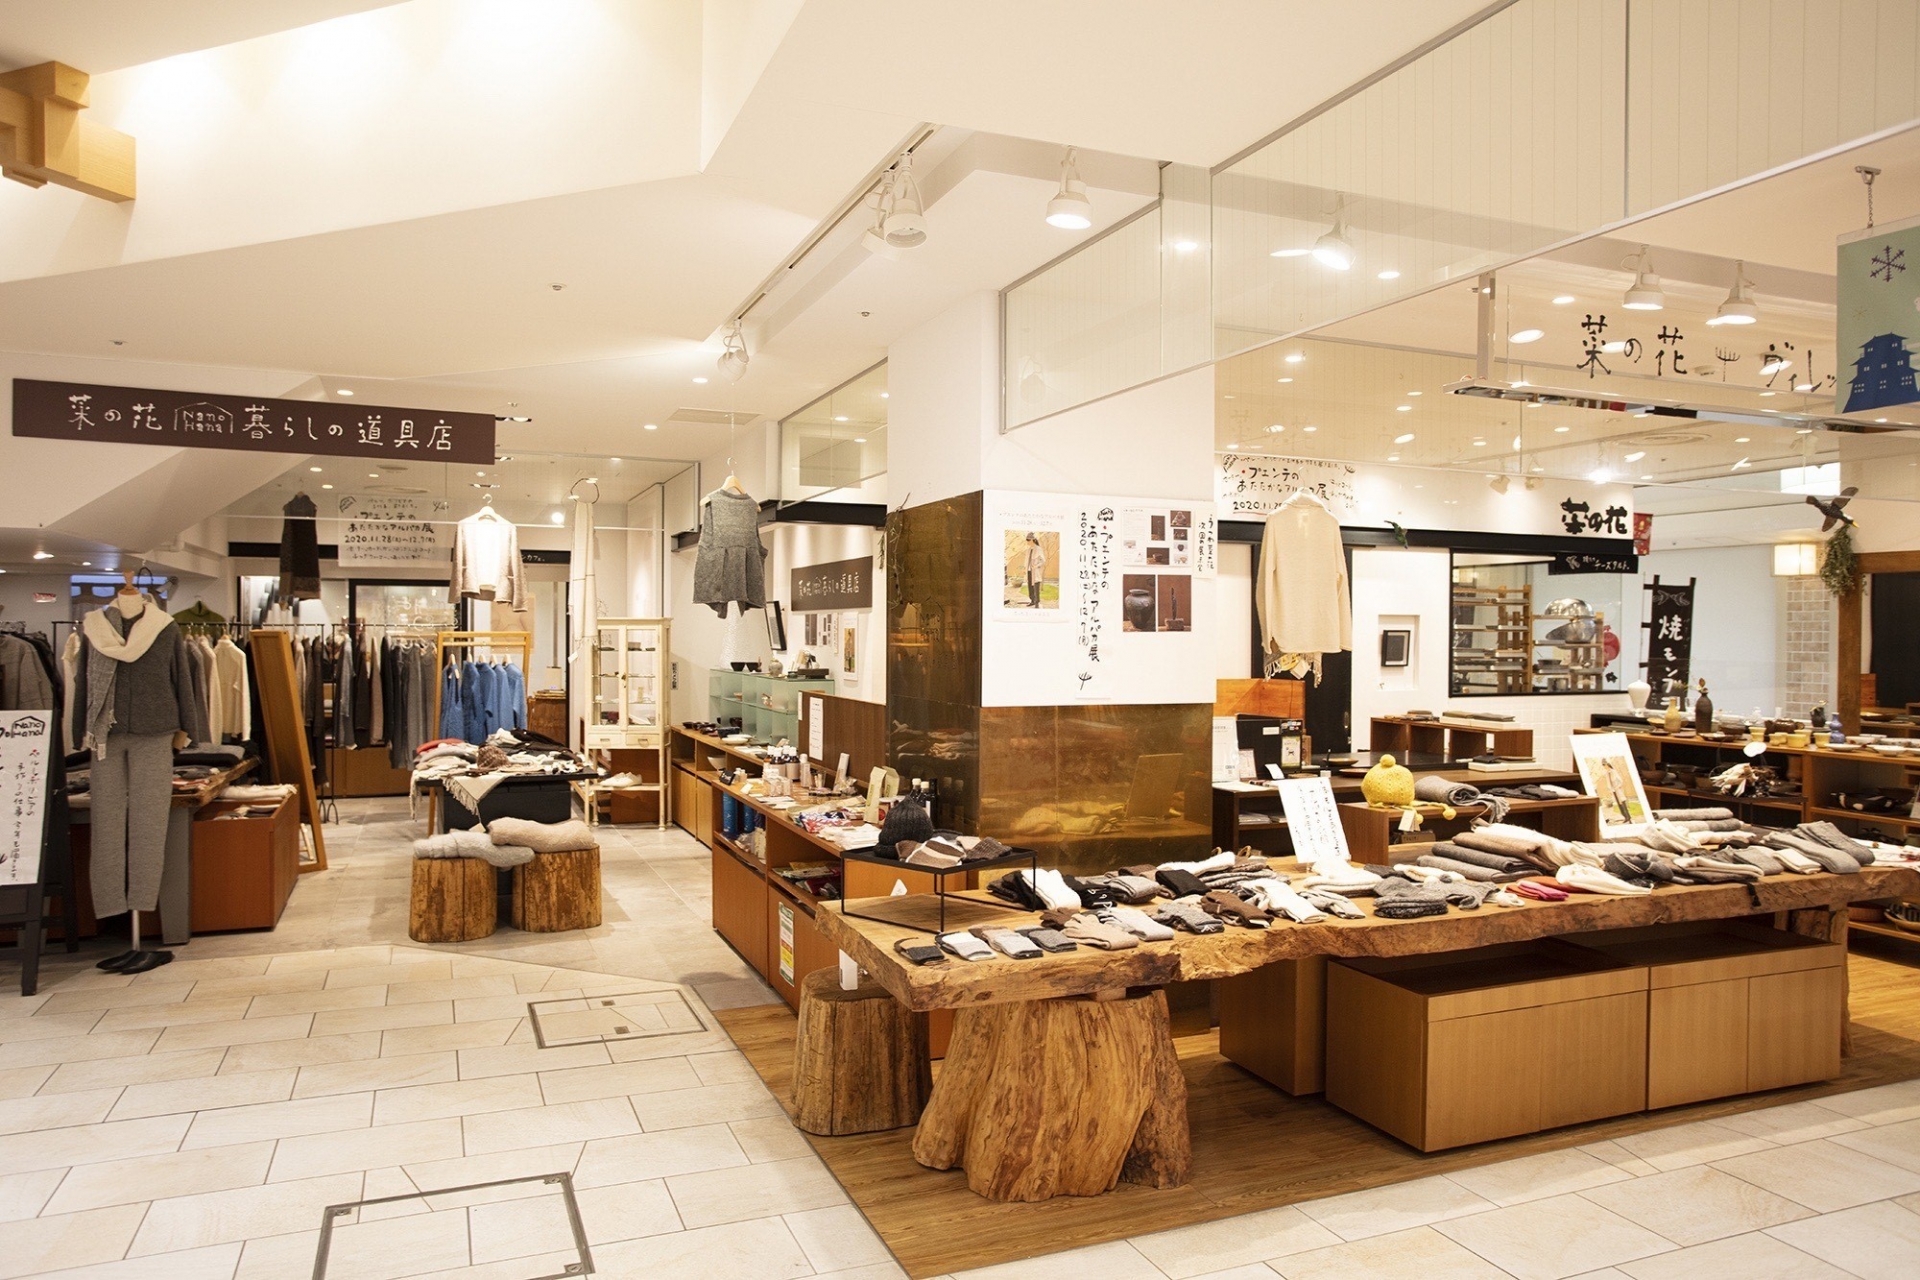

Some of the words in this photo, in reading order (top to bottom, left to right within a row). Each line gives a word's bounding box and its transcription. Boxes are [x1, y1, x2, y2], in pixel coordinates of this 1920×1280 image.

[1576, 314, 1687, 378] 菜の花
[67, 394, 163, 431] 菜の花
[242, 404, 453, 451] 暮らしの道具店
[183, 410, 226, 422] Nano
[184, 420, 223, 433] Hana
[1560, 497, 1628, 534] 菜の花
